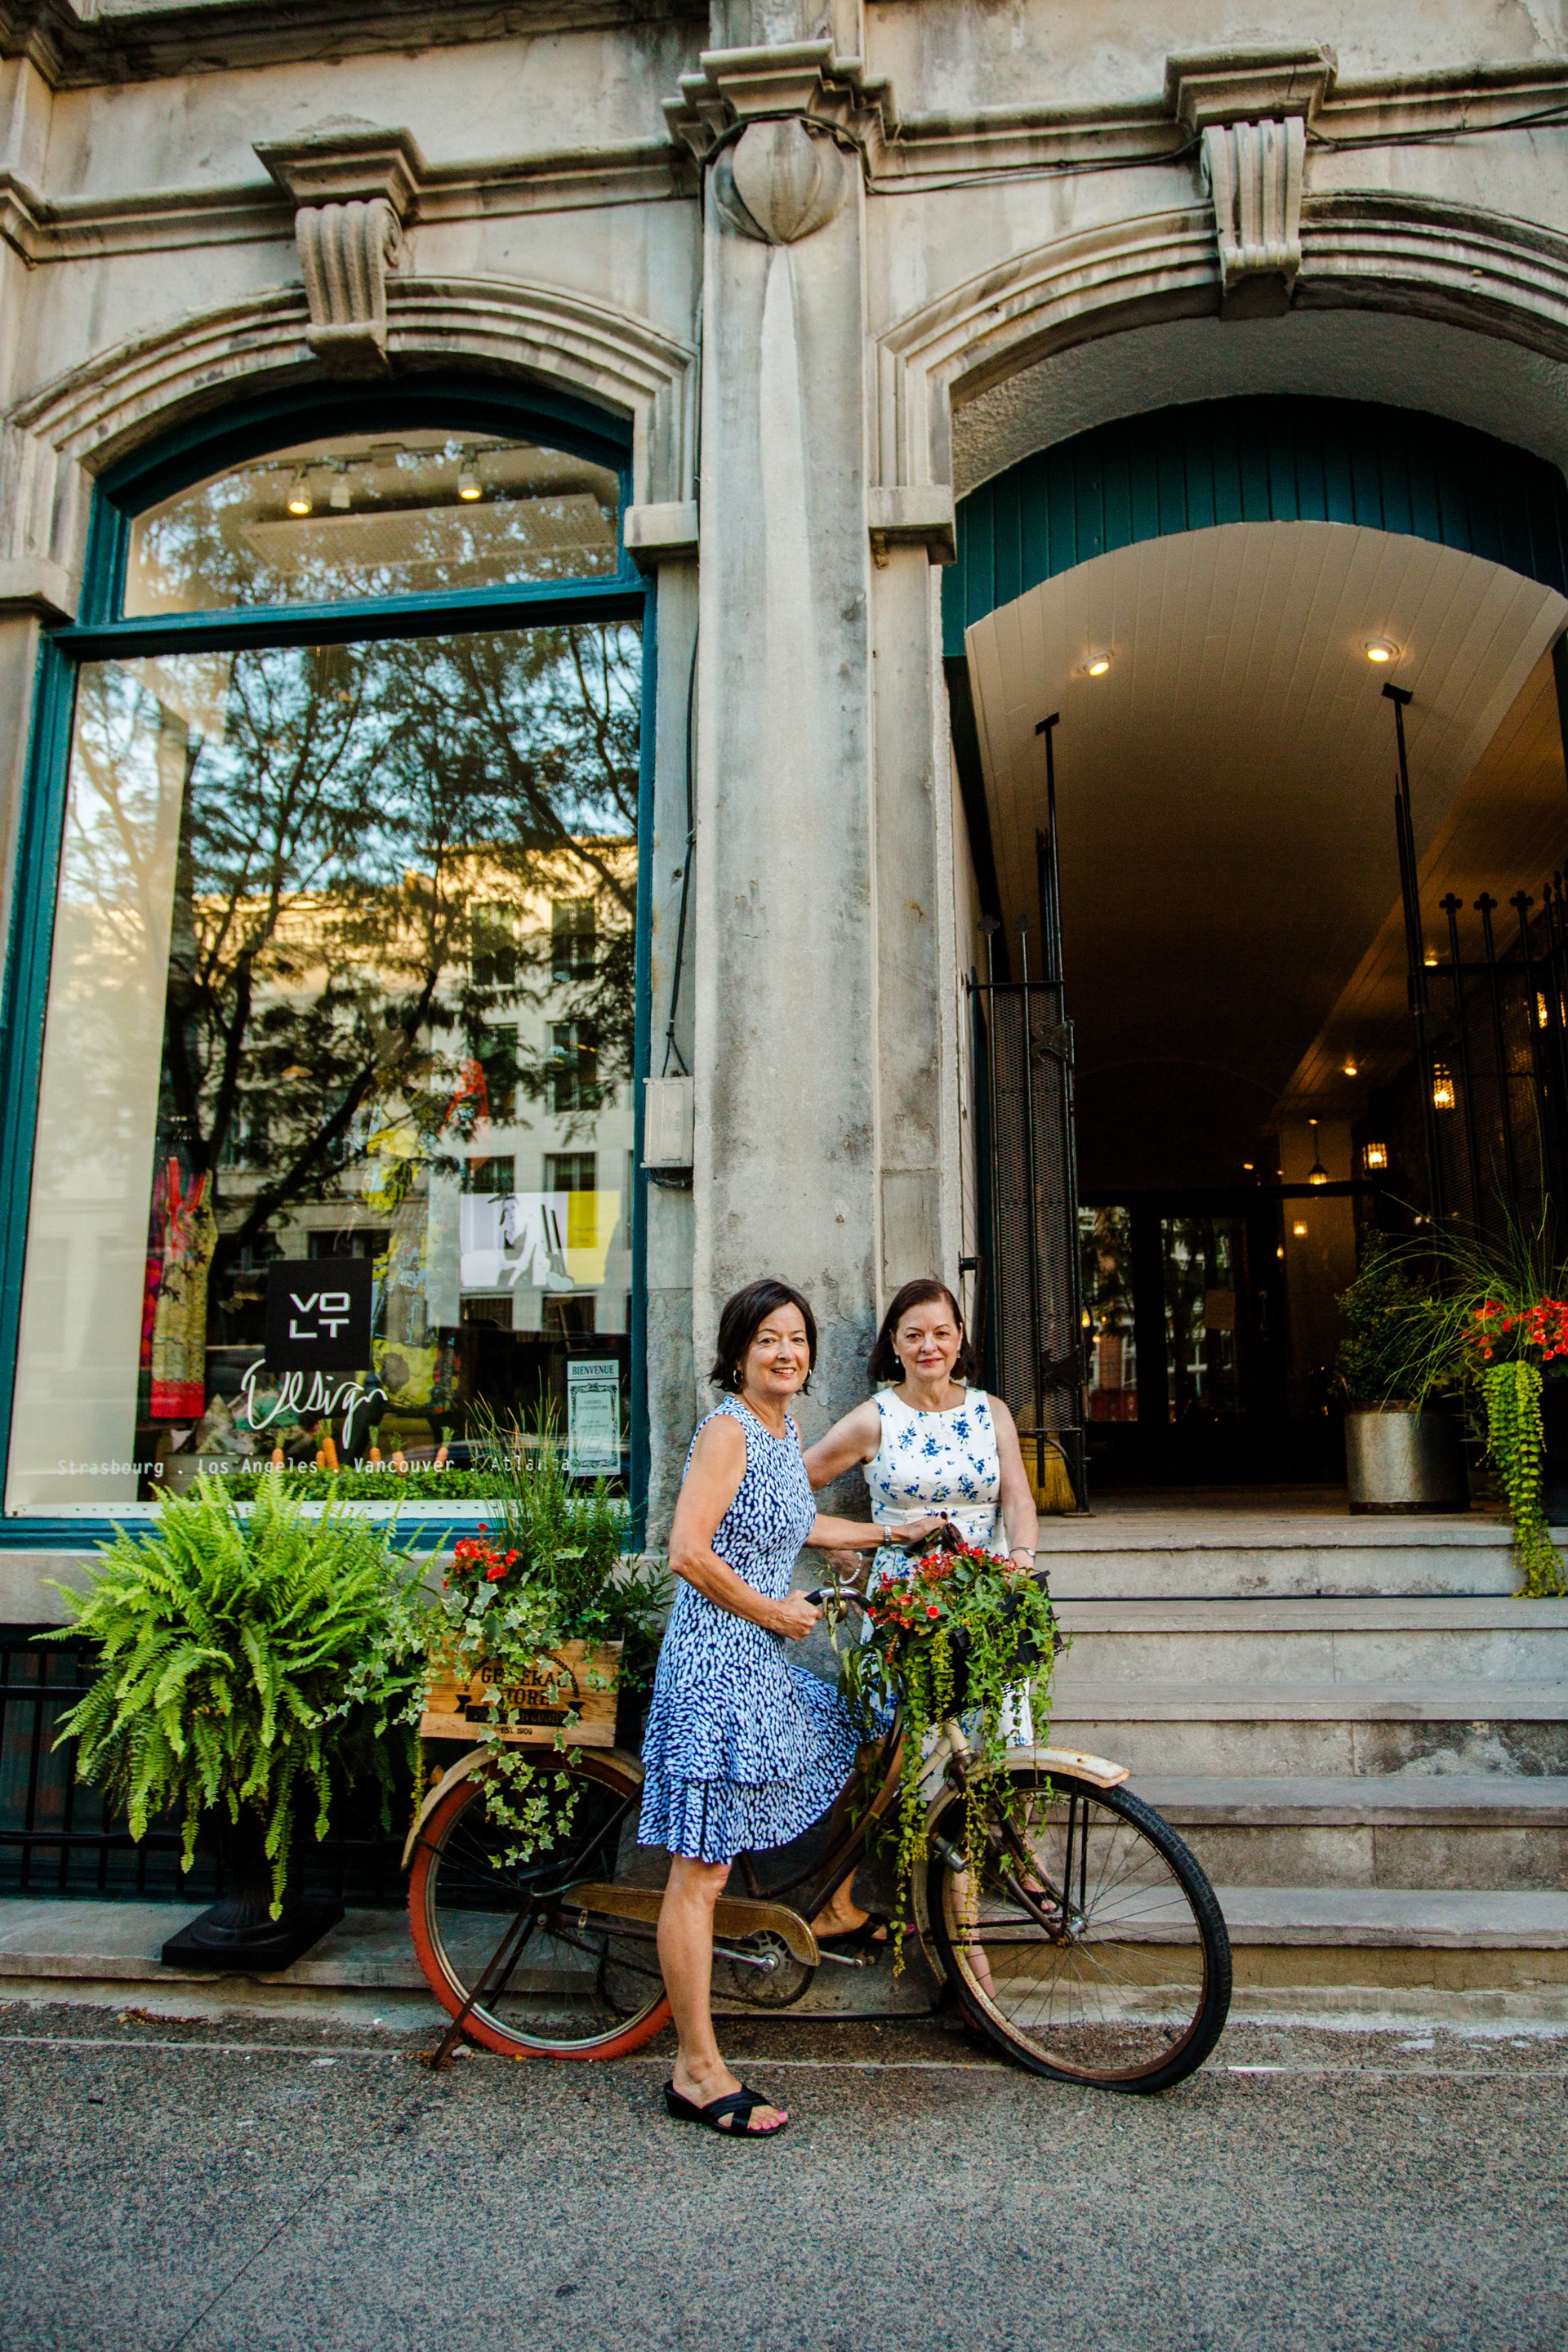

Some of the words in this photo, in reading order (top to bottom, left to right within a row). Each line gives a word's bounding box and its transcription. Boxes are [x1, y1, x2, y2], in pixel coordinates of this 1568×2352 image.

[572, 1365, 614, 1375] BIENVENUE
[57, 1459, 164, 1477] Strasbourg
[198, 1459, 229, 1475] Los
[242, 1458, 318, 1477] Angeles
[354, 1457, 455, 1473] Vancouver
[481, 1667, 567, 1687] GEERAL
[497, 1688, 551, 1705] TORE
